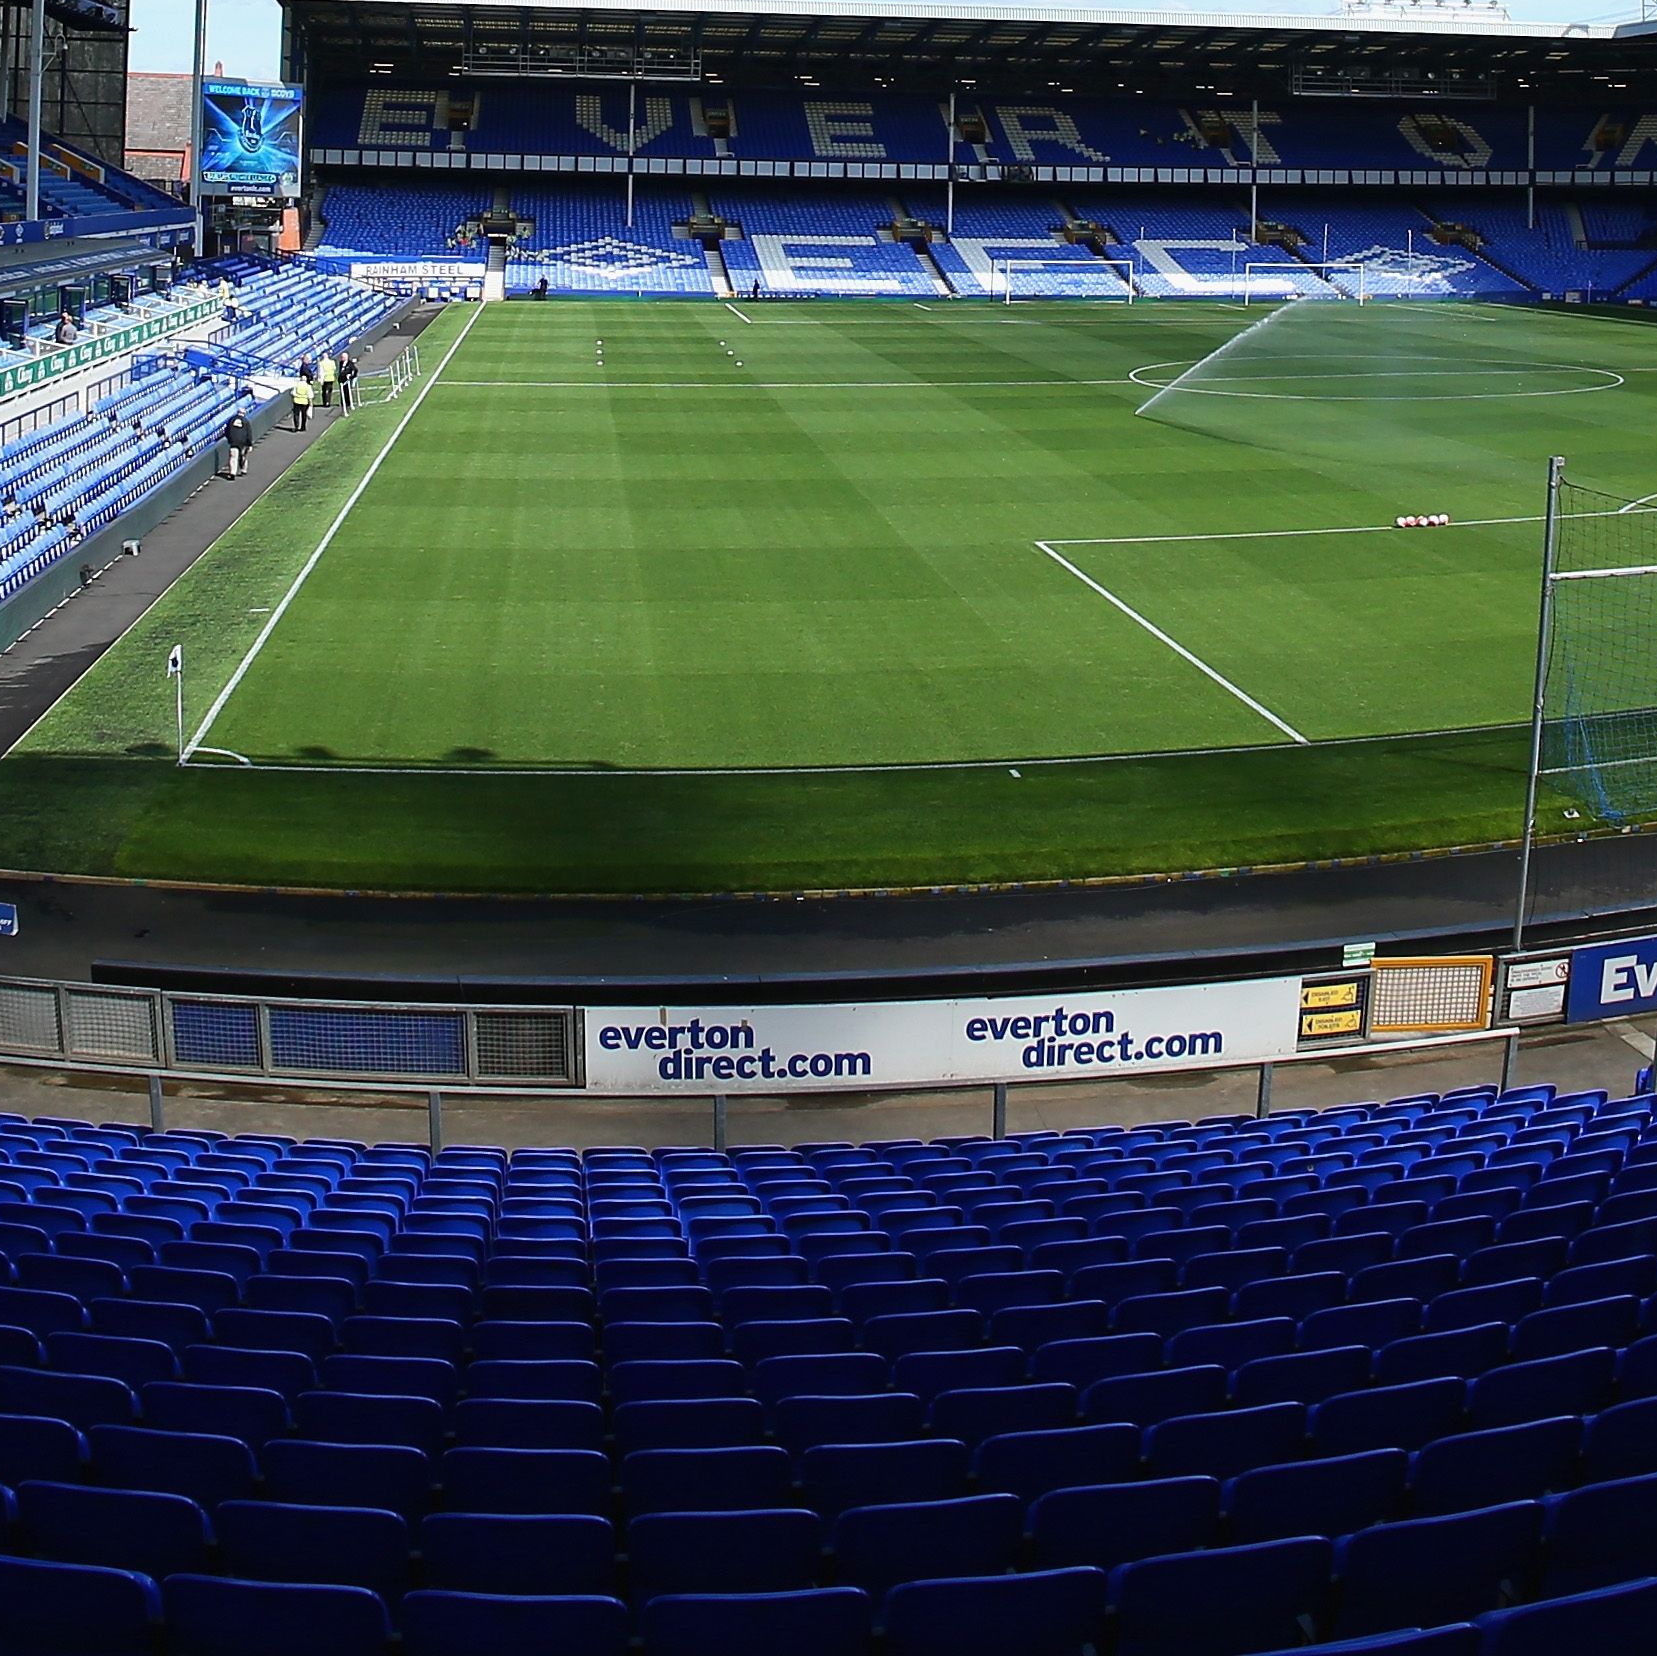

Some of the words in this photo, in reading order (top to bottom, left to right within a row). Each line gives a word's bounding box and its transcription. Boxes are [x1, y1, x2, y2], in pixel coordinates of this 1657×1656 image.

[366, 265, 417, 276] RAINHAM
[421, 264, 464, 275] STEEL
[0, 918, 13, 926] OFF
[598, 1017, 755, 1052] everton
[966, 1007, 1115, 1044] everton
[657, 1047, 872, 1082] direct.com
[1021, 1027, 1223, 1070] direct.com
